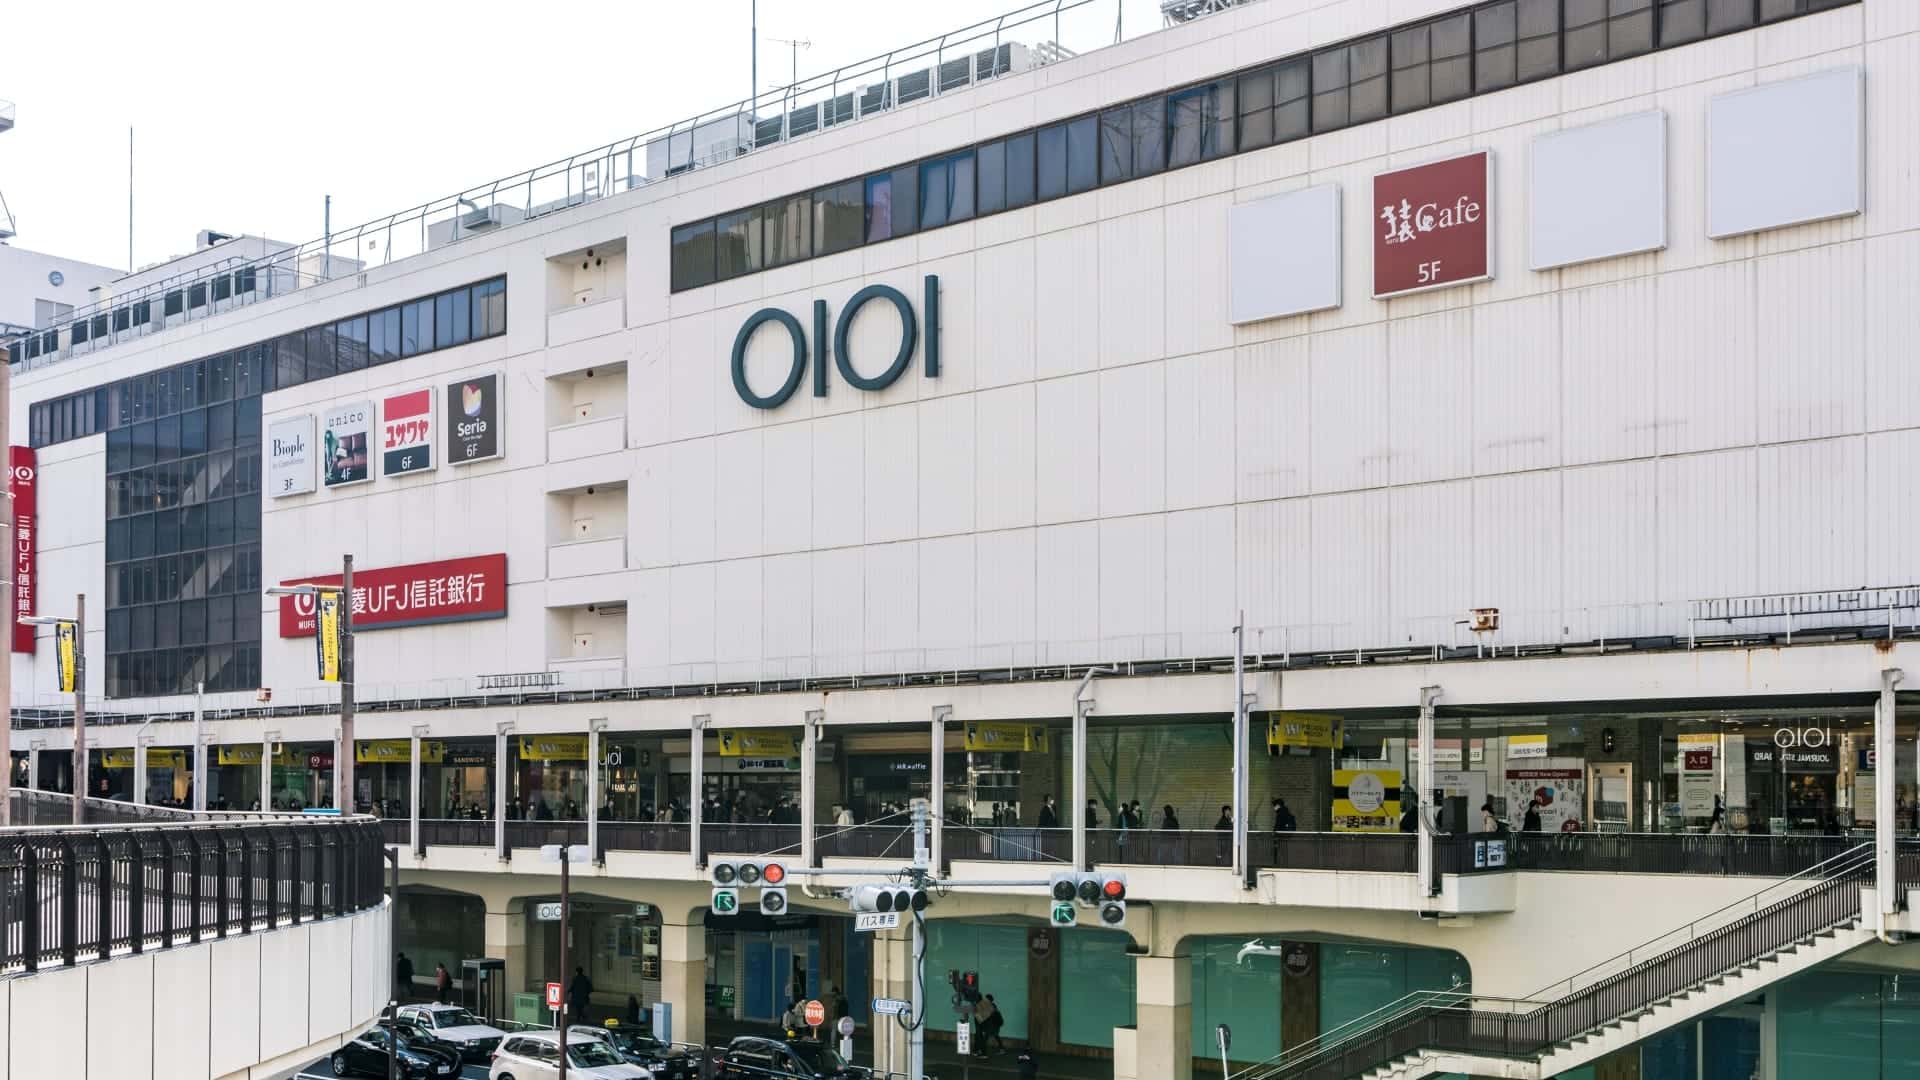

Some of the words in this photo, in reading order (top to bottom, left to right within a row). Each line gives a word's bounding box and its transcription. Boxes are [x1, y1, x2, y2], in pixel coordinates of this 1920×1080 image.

[1418, 260, 1441, 283] 5F
[328, 411, 364, 427] unico
[457, 418, 487, 438] Seria
[273, 433, 305, 457] Biople
[466, 444, 478, 457] 6F
[401, 456, 412, 470] 6F
[341, 468, 352, 480] 4F
[284, 479, 294, 490] 3F
[352, 573, 486, 615] 菱UFJ信託銀行
[298, 620, 316, 630] MUFG
[1689, 755, 1708, 765] 入口
[861, 914, 896, 928] バス専用
